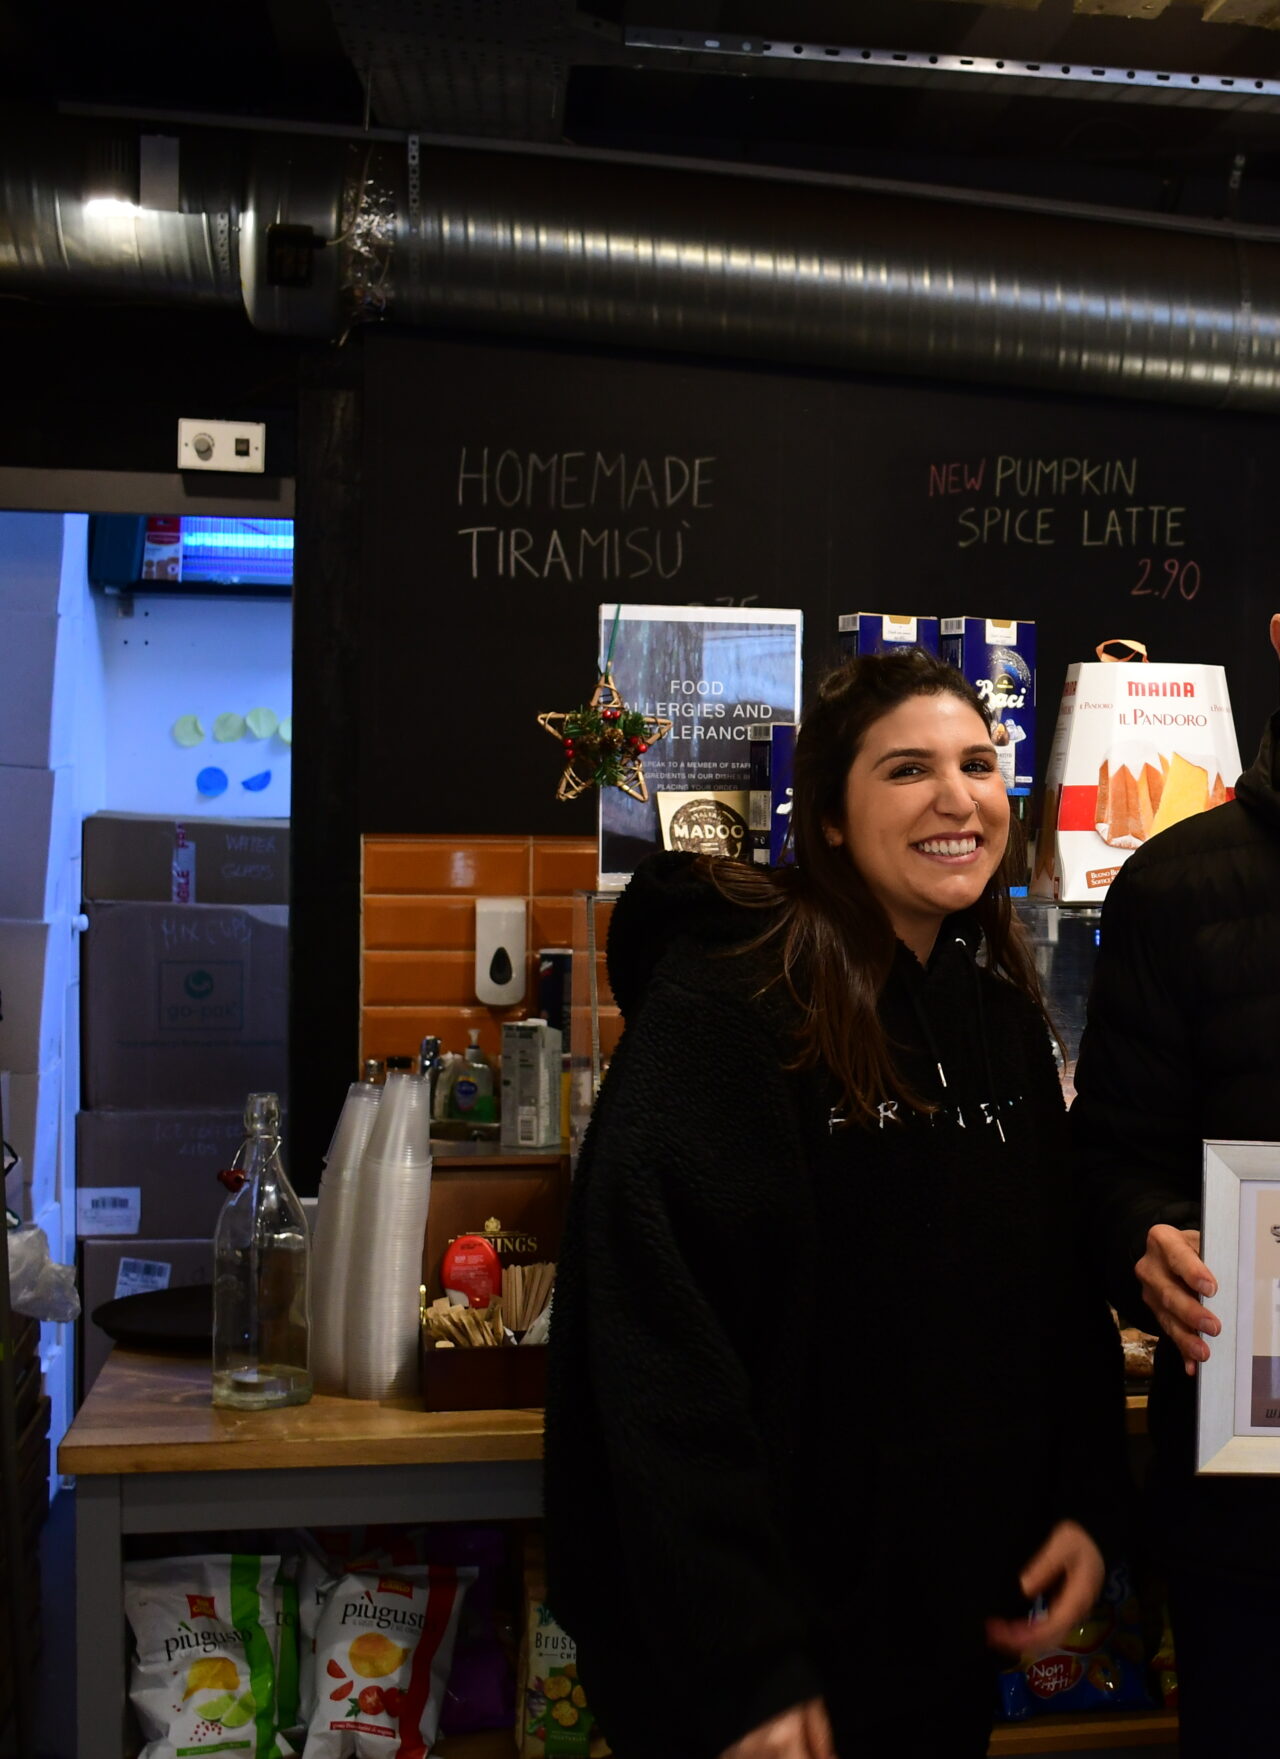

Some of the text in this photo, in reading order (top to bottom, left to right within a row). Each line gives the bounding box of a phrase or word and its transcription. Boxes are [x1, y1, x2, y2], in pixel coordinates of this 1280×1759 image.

[458, 446, 717, 509] HOMEMADE
[928, 454, 1138, 497] NEW PUMPKIN
[957, 505, 1187, 548] SPICE LATTE
[457, 519, 690, 582] TIRAMISÙ
[1130, 557, 1200, 600] 2.90
[670, 680, 724, 696] FOOD
[1127, 681, 1195, 698] MAINA
[732, 705, 773, 719] AND
[1119, 714, 1130, 726] IL
[673, 823, 745, 840] MADOO
[341, 1590, 427, 1629] piùgust
[164, 1620, 253, 1662] piùgusto
